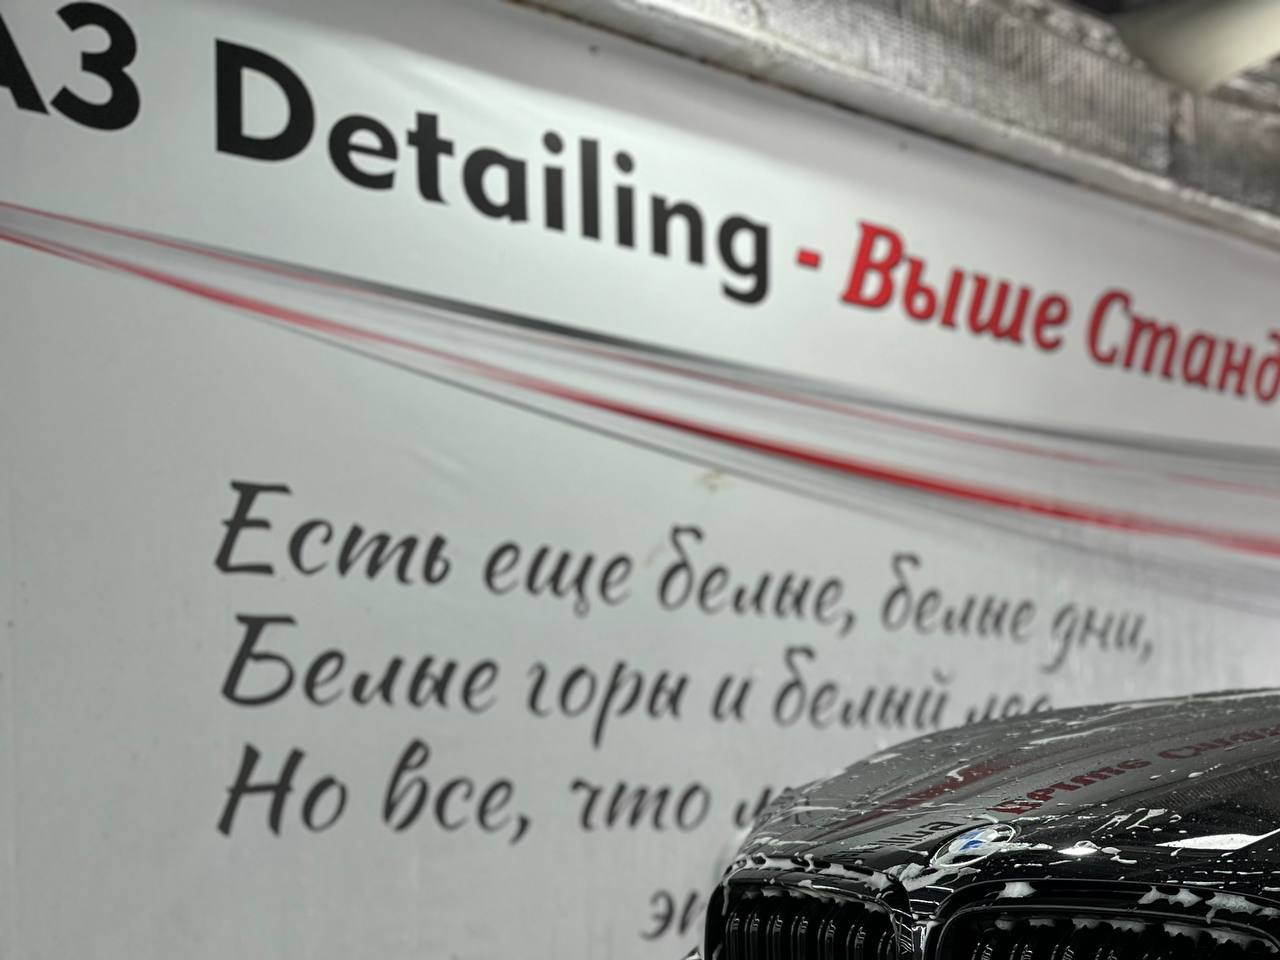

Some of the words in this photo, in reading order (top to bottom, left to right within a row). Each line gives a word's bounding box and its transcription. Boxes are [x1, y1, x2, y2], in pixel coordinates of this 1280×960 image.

[214, 38, 770, 306] Detailing
[841, 221, 1070, 354] Выше
[213, 480, 451, 585] Есть
[482, 541, 633, 618] еще
[220, 613, 499, 714] Белые
[527, 660, 688, 749] горы
[711, 674, 753, 722] и
[216, 743, 348, 837] Но
[382, 738, 531, 844] все,
[570, 777, 711, 832] что
